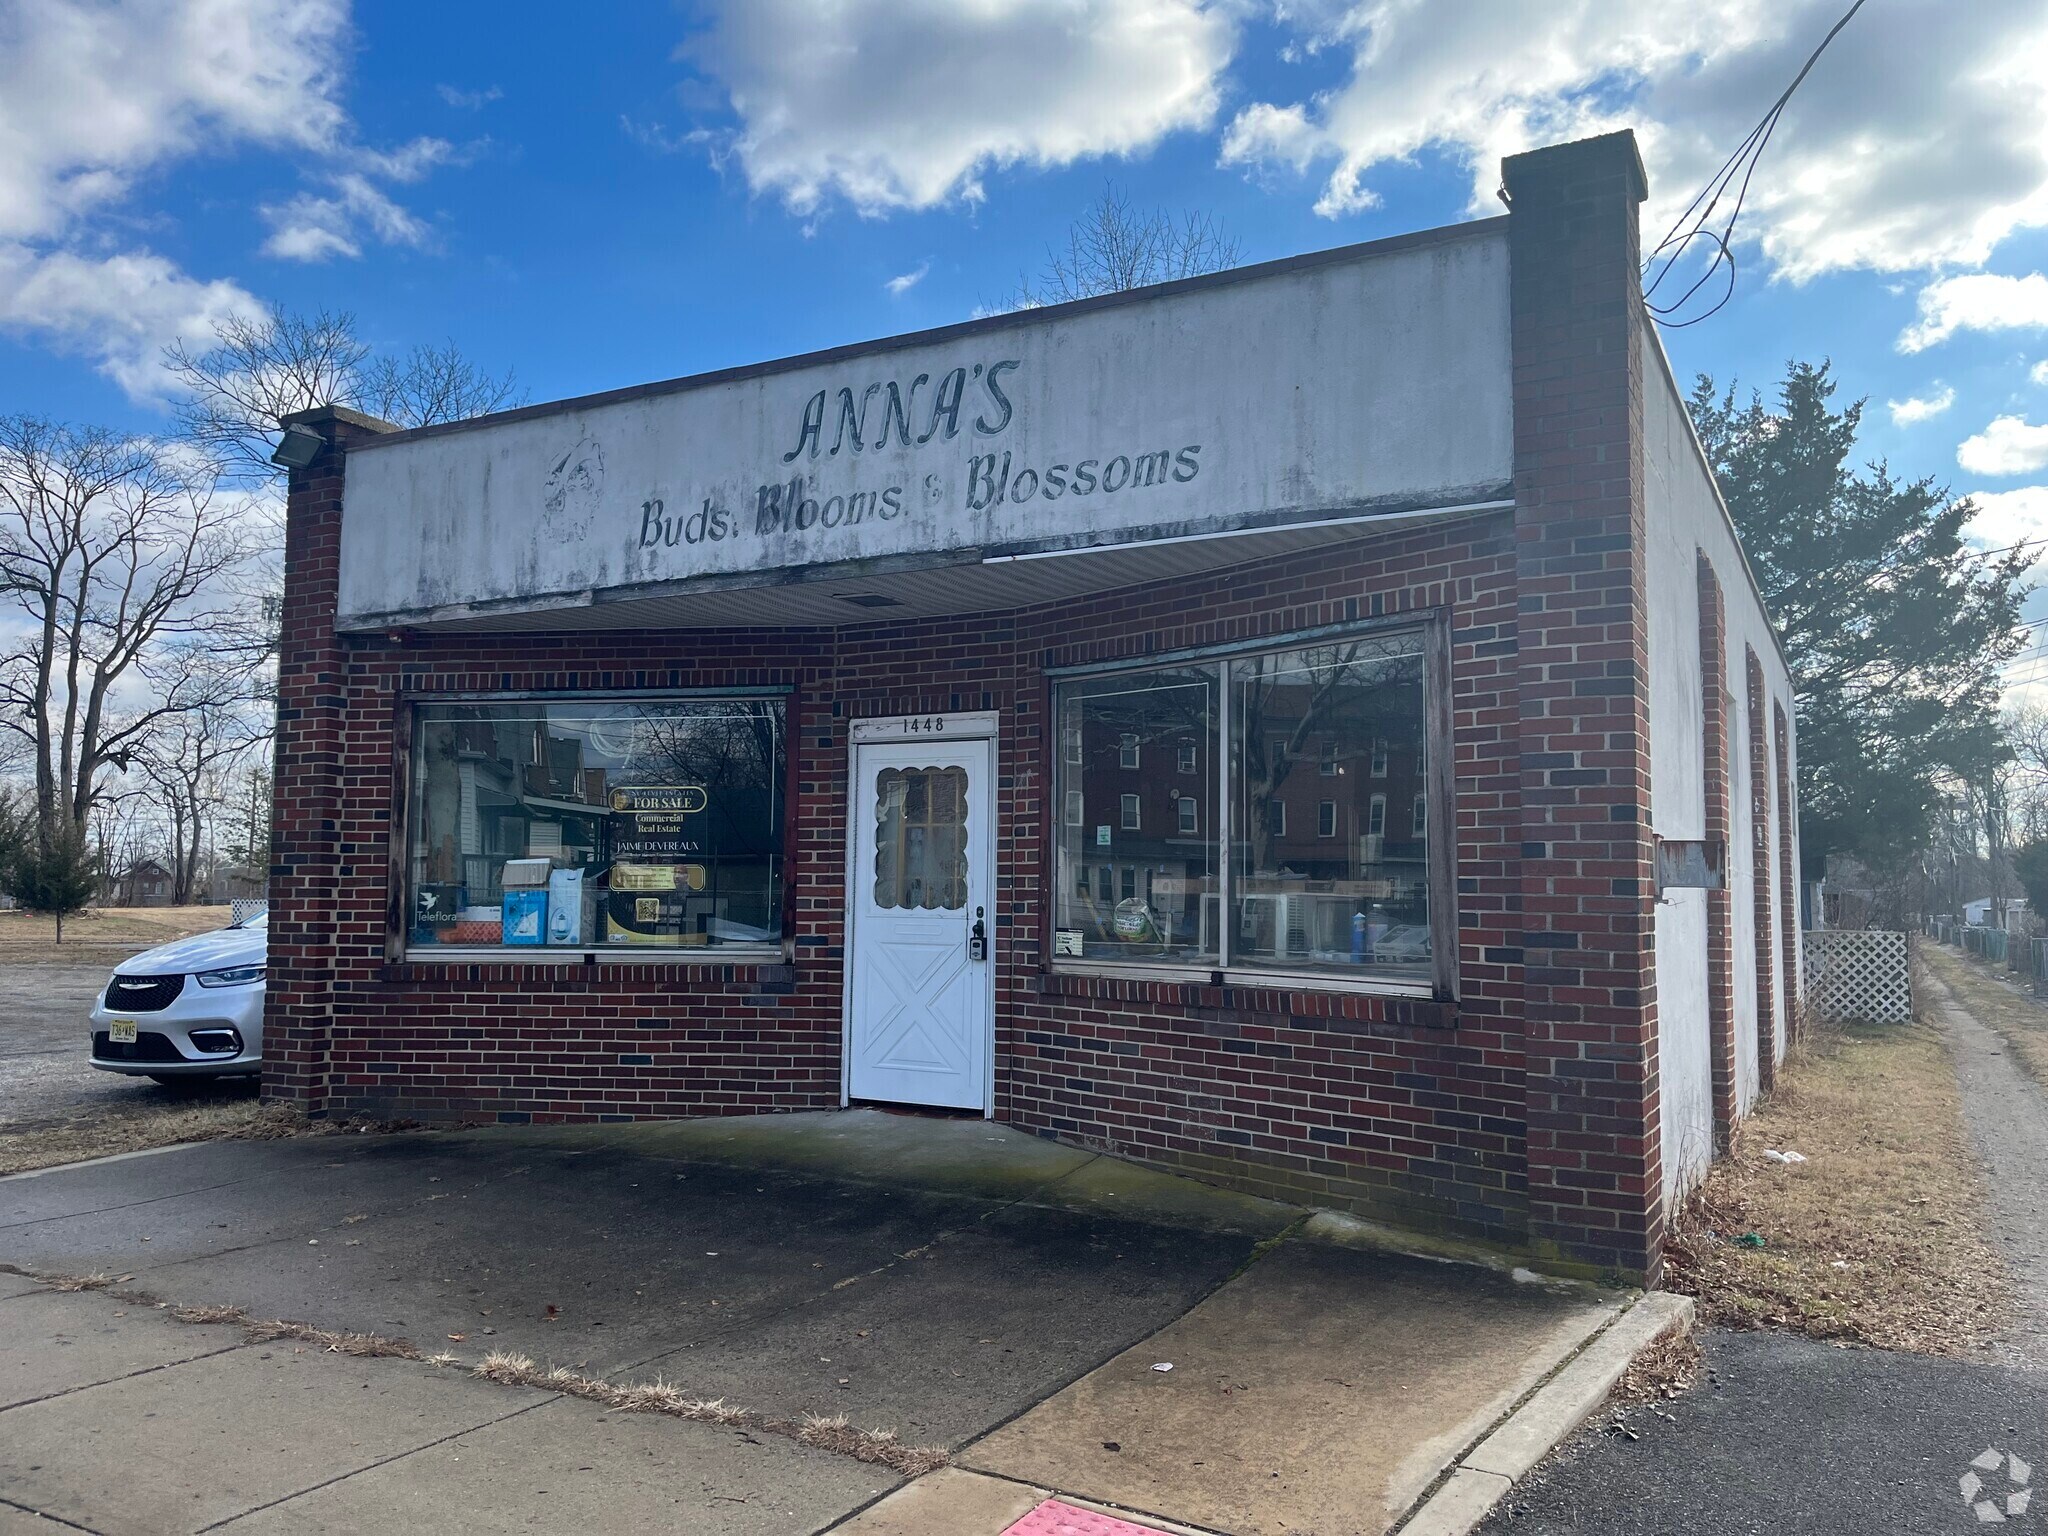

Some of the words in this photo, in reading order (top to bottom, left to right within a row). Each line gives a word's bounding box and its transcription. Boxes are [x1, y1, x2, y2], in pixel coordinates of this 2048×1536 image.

[782, 359, 1021, 463] ANNA'S
[965, 444, 1202, 511] Blossoms
[903, 717, 944, 733] 1448
[634, 797, 659, 809] FOR
[661, 797, 692, 809] SALE
[635, 813, 684, 823] Commercial
[638, 824, 656, 833] Real
[656, 825, 681, 833] Estate
[617, 841, 642, 852] JAIME
[644, 841, 699, 851] DEVEREAUX
[416, 910, 457, 922] Teleflora
